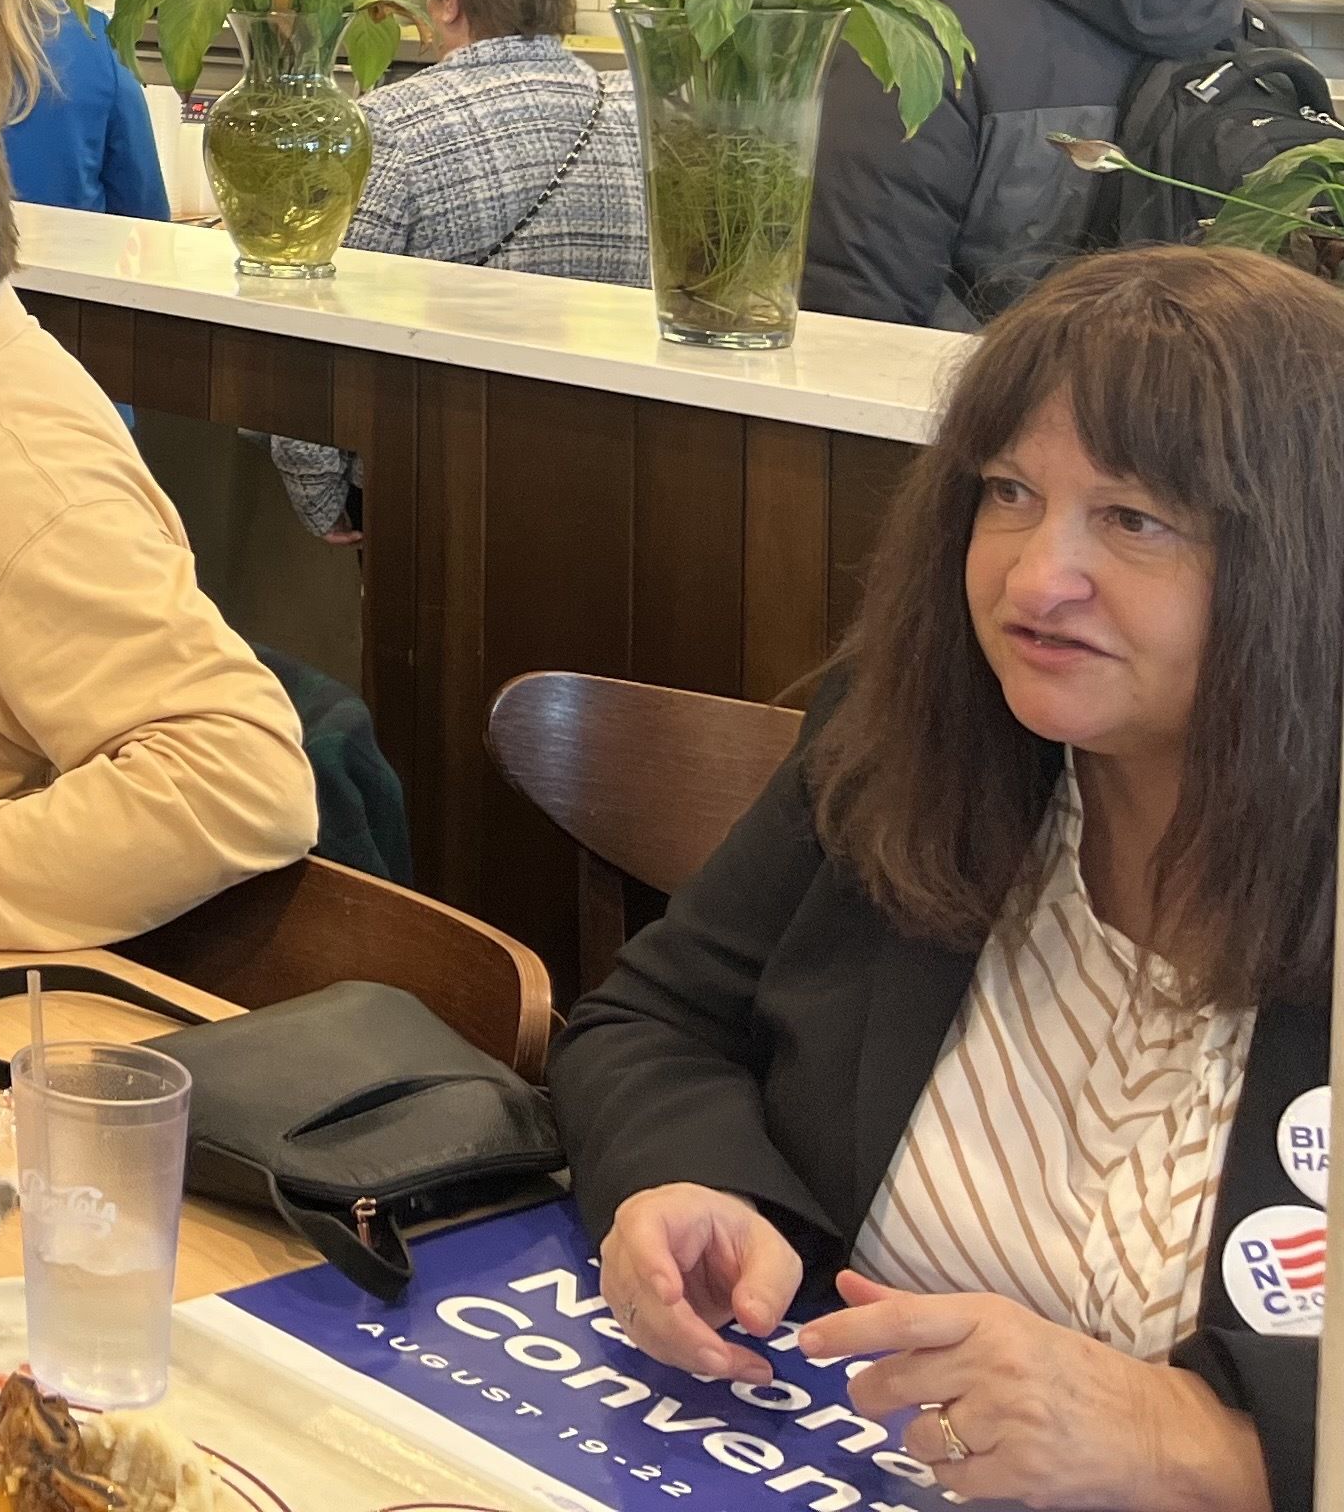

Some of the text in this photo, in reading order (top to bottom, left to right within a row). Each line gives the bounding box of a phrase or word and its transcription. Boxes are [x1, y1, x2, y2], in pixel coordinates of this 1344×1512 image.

[1295, 1292, 1326, 1312] 20
[356, 1322, 693, 1497] AUGUST 19-22
